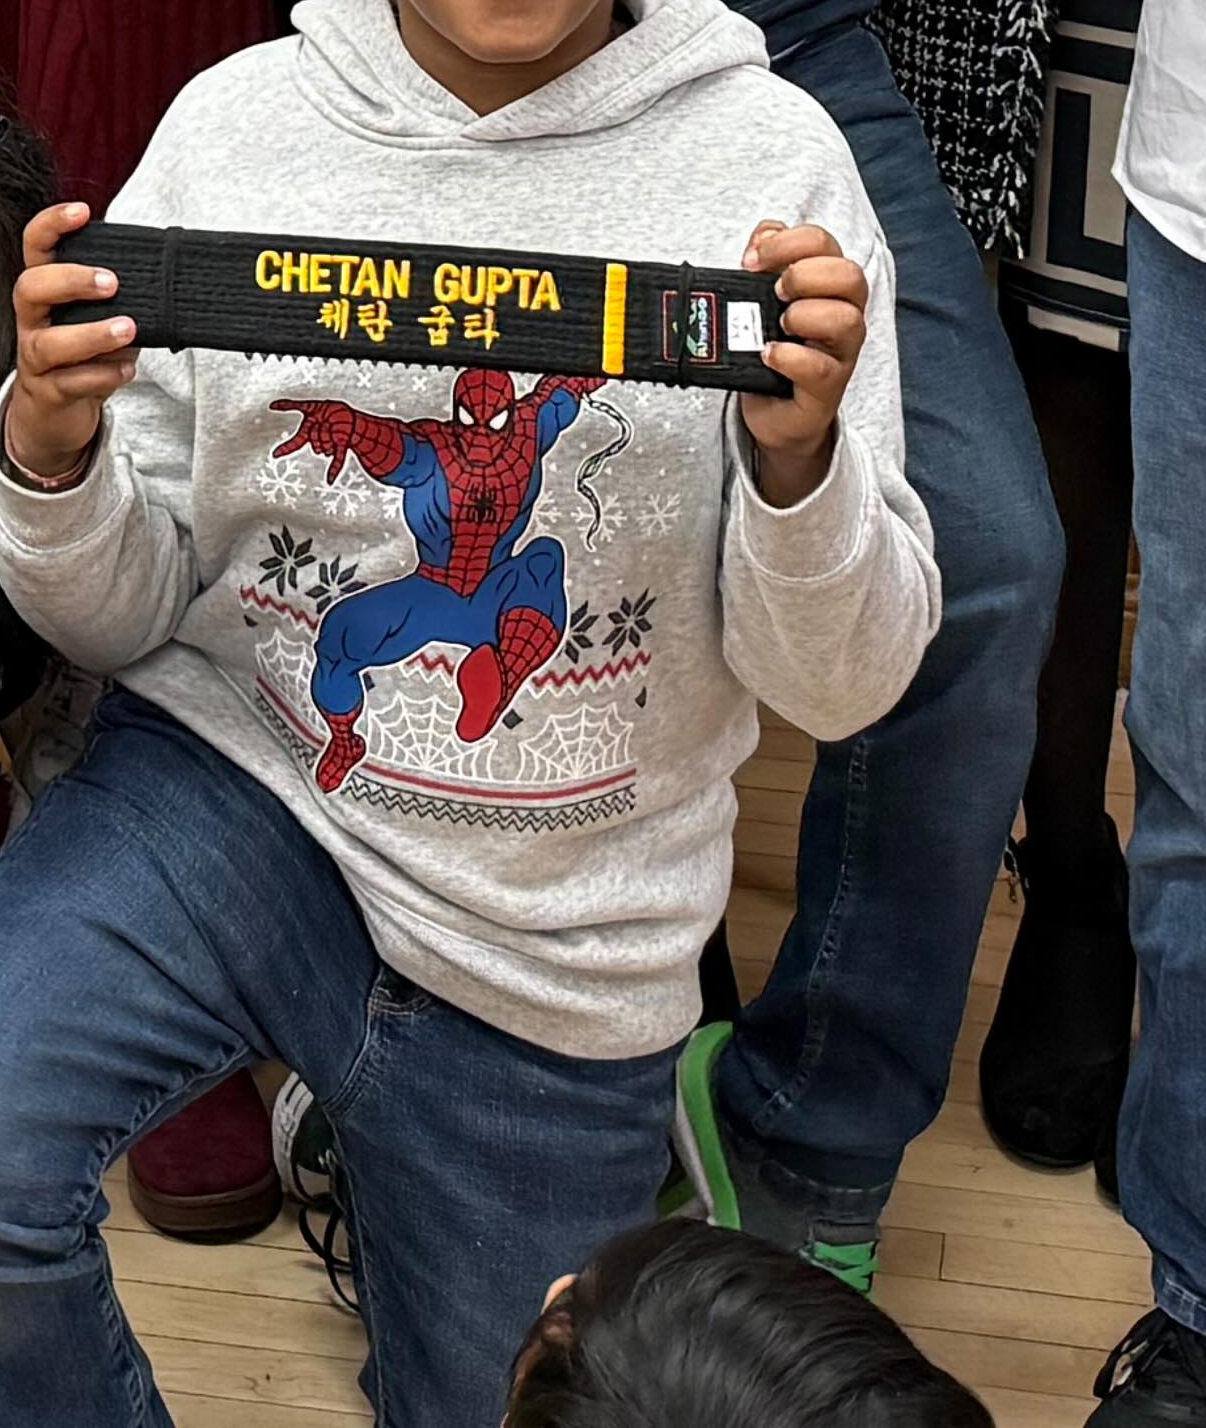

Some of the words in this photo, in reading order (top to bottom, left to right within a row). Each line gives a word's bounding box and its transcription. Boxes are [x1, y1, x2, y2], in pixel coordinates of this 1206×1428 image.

[254, 250, 412, 300] CHETAN
[432, 262, 562, 312] GUPTA
[417, 304, 501, 351] 굽타
